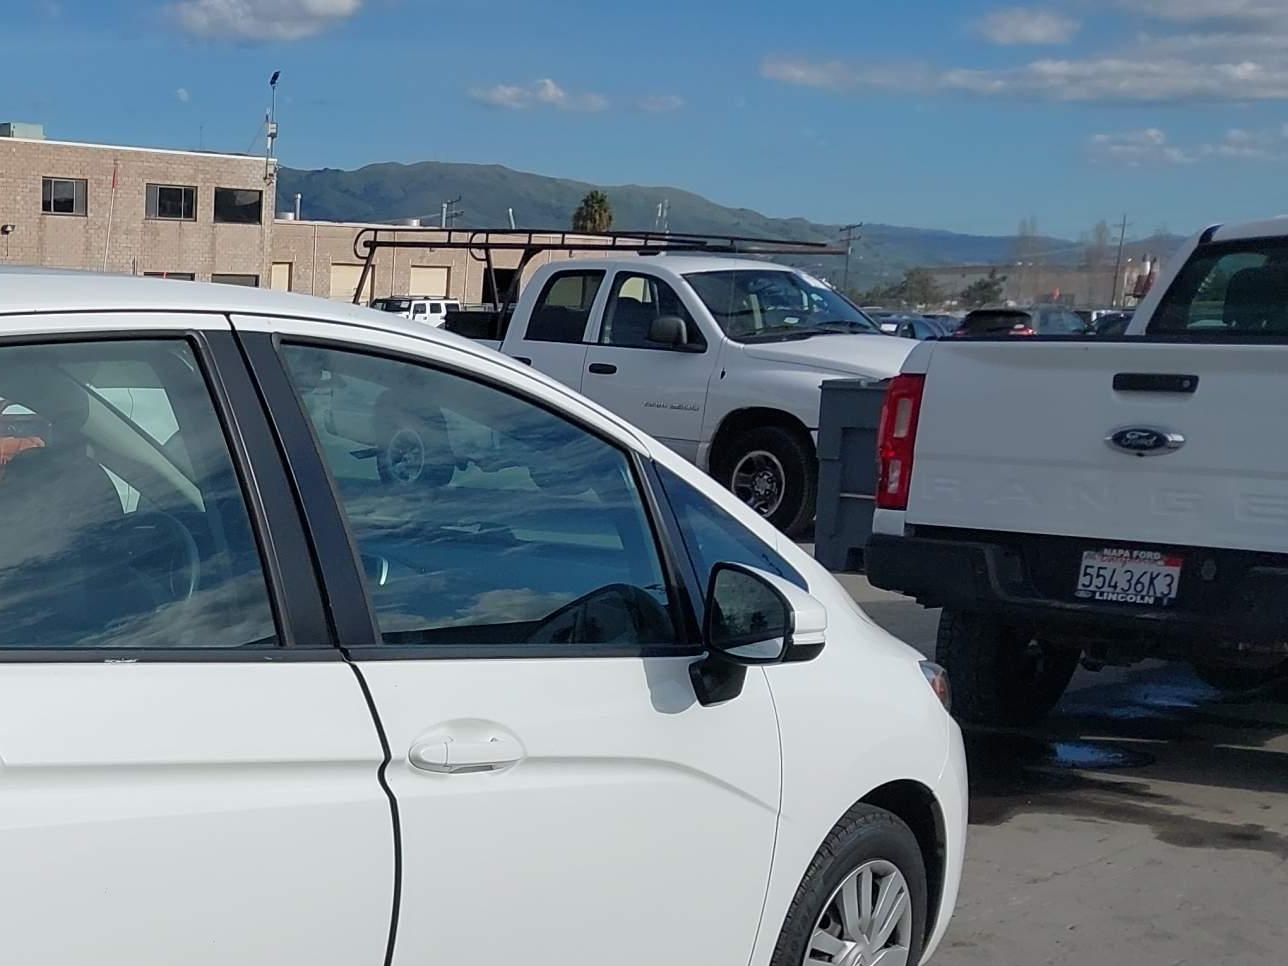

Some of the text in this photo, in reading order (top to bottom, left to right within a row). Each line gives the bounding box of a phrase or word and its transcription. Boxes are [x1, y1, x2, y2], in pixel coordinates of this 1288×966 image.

[1121, 430, 1157, 447] Ford
[1103, 548, 1161, 560] NAPA FORD
[1080, 564, 1175, 598] 55436K3
[1095, 591, 1155, 605] LINCOLN
